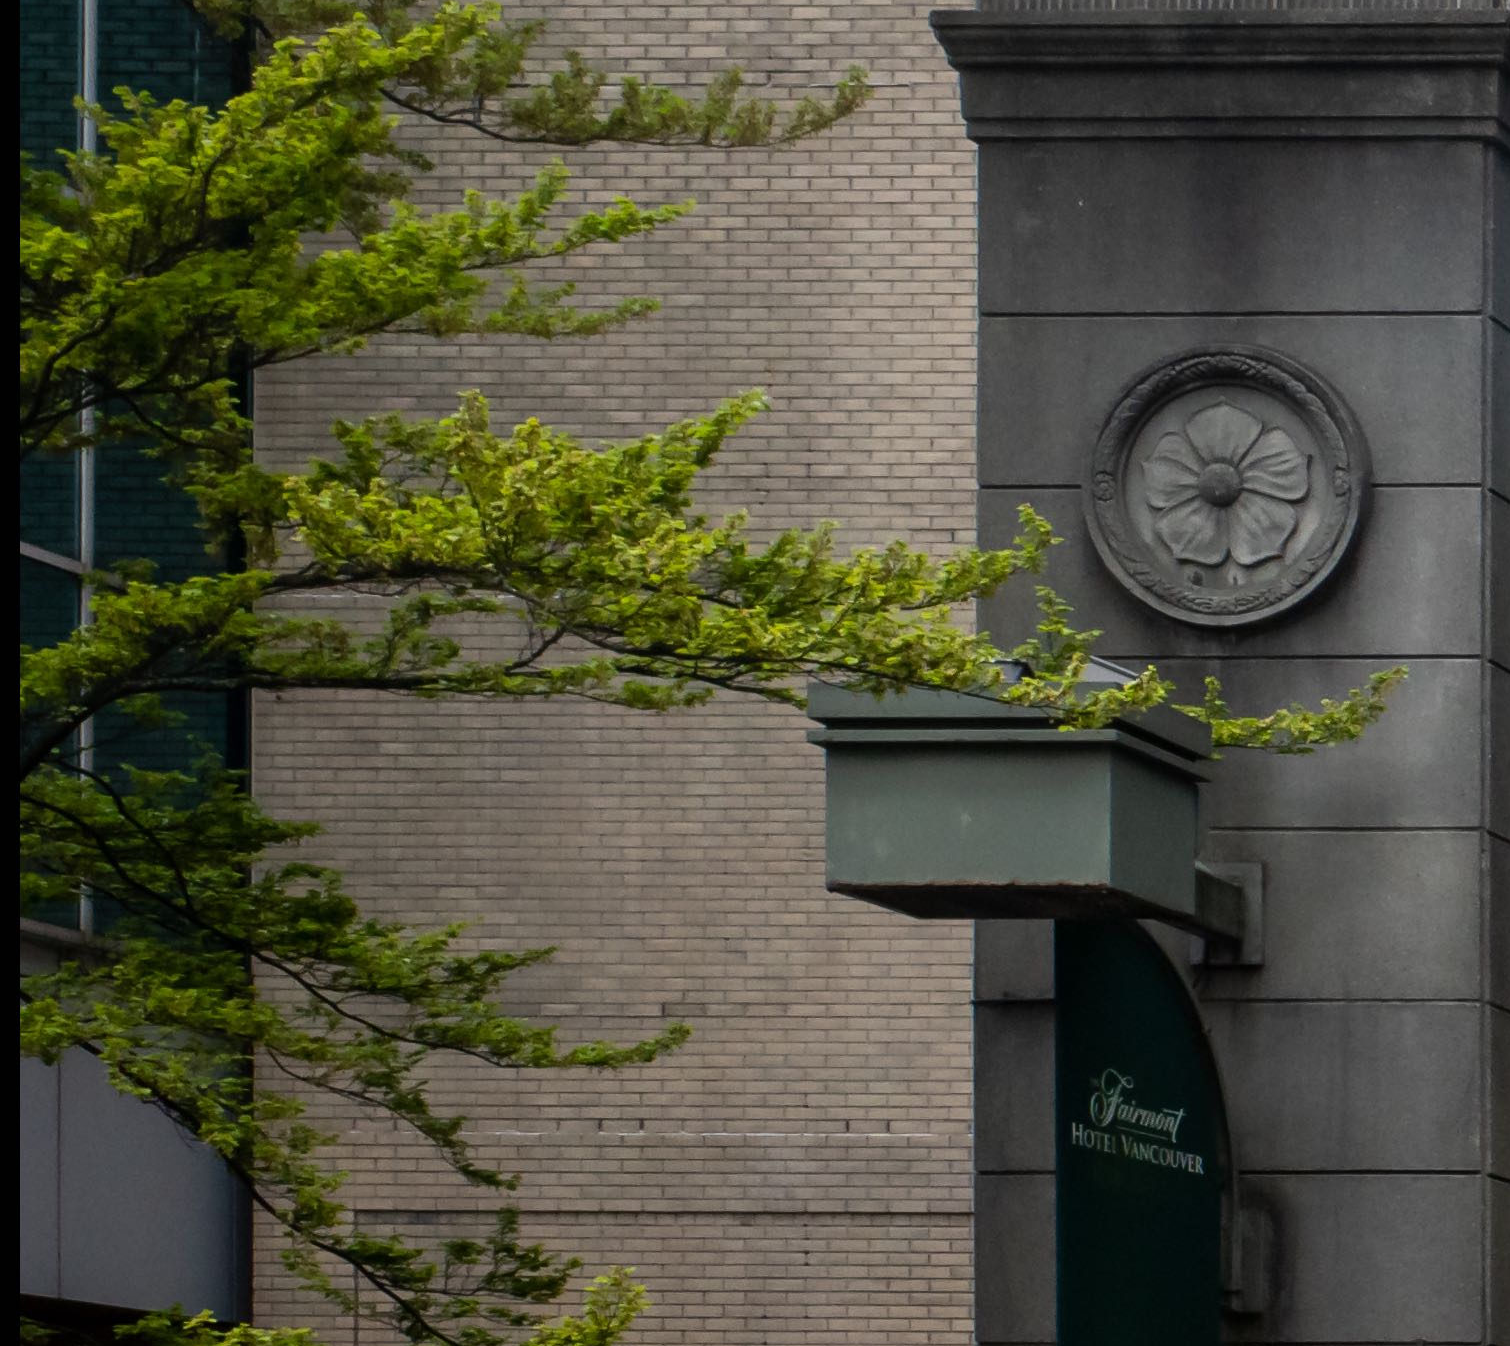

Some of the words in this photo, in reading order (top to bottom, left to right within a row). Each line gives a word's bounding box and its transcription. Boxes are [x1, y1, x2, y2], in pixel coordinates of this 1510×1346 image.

[1090, 1068, 1187, 1144] Fairmont
[1071, 1122, 1117, 1154] HOTEL
[1121, 1134, 1205, 1175] VANCOUVER
